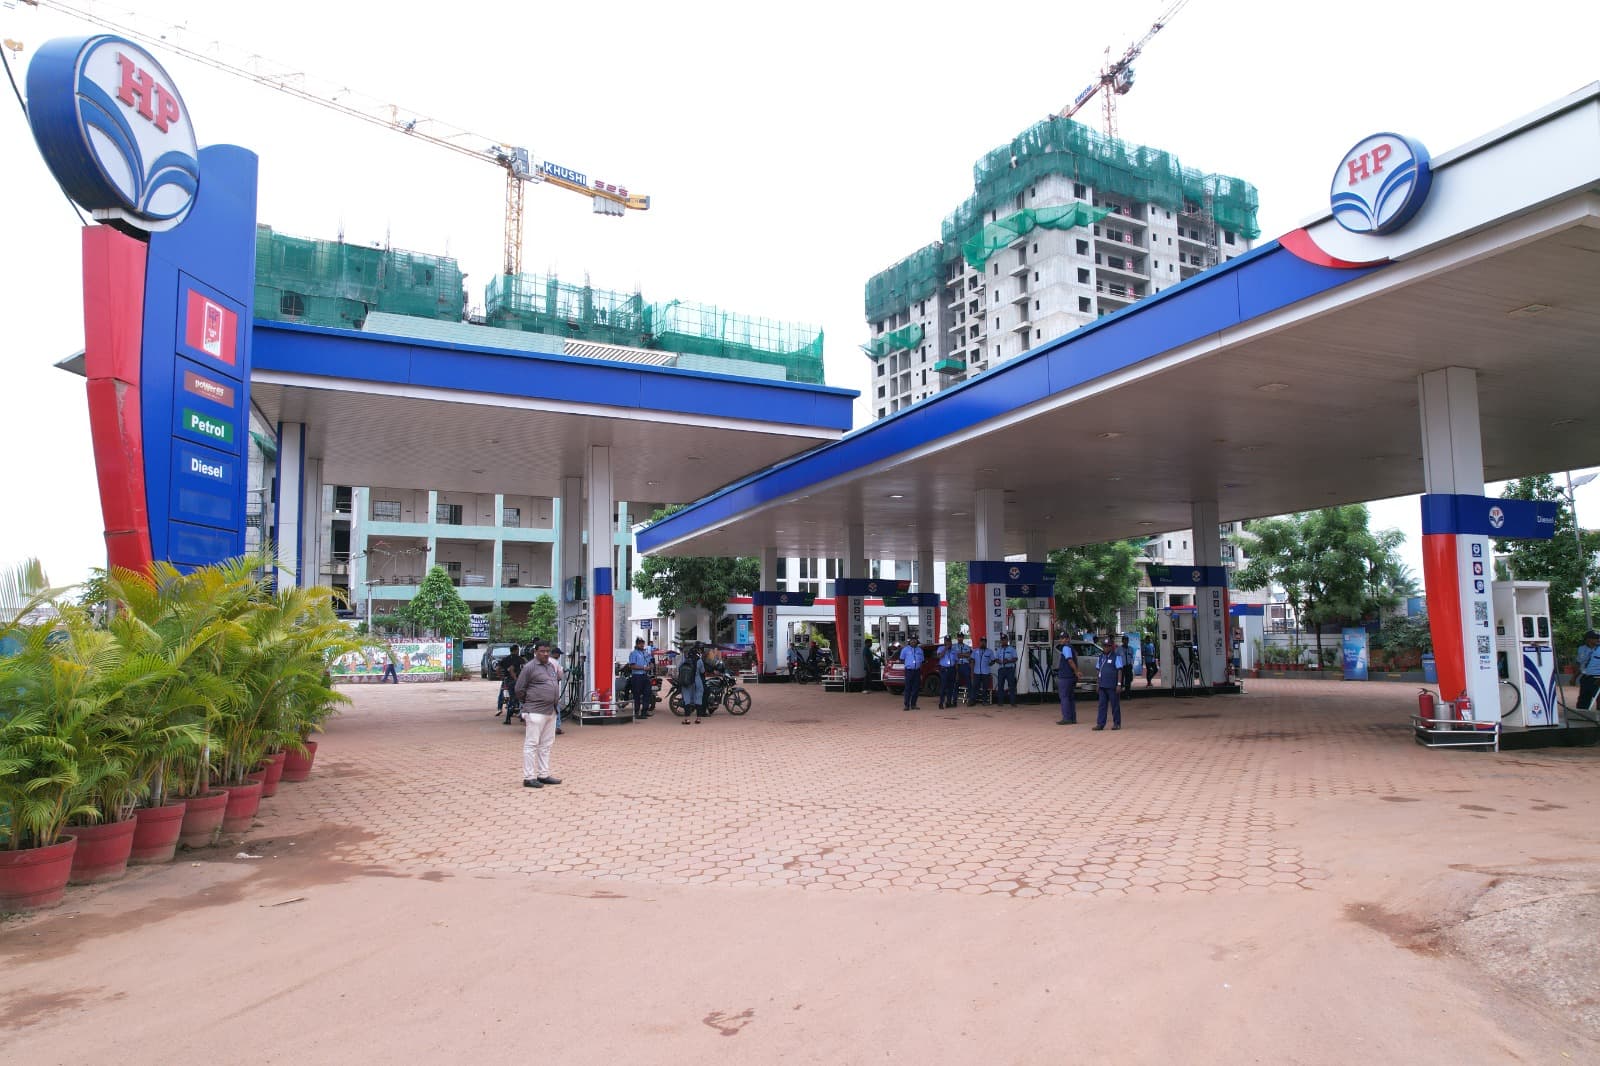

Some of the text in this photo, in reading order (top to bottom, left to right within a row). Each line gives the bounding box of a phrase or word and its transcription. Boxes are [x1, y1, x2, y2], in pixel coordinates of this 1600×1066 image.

[117, 51, 180, 134] HP
[545, 162, 586, 185] KHUSHI
[1347, 143, 1392, 186] HP
[191, 414, 225, 438] Petrol
[191, 457, 223, 478] Diesel
